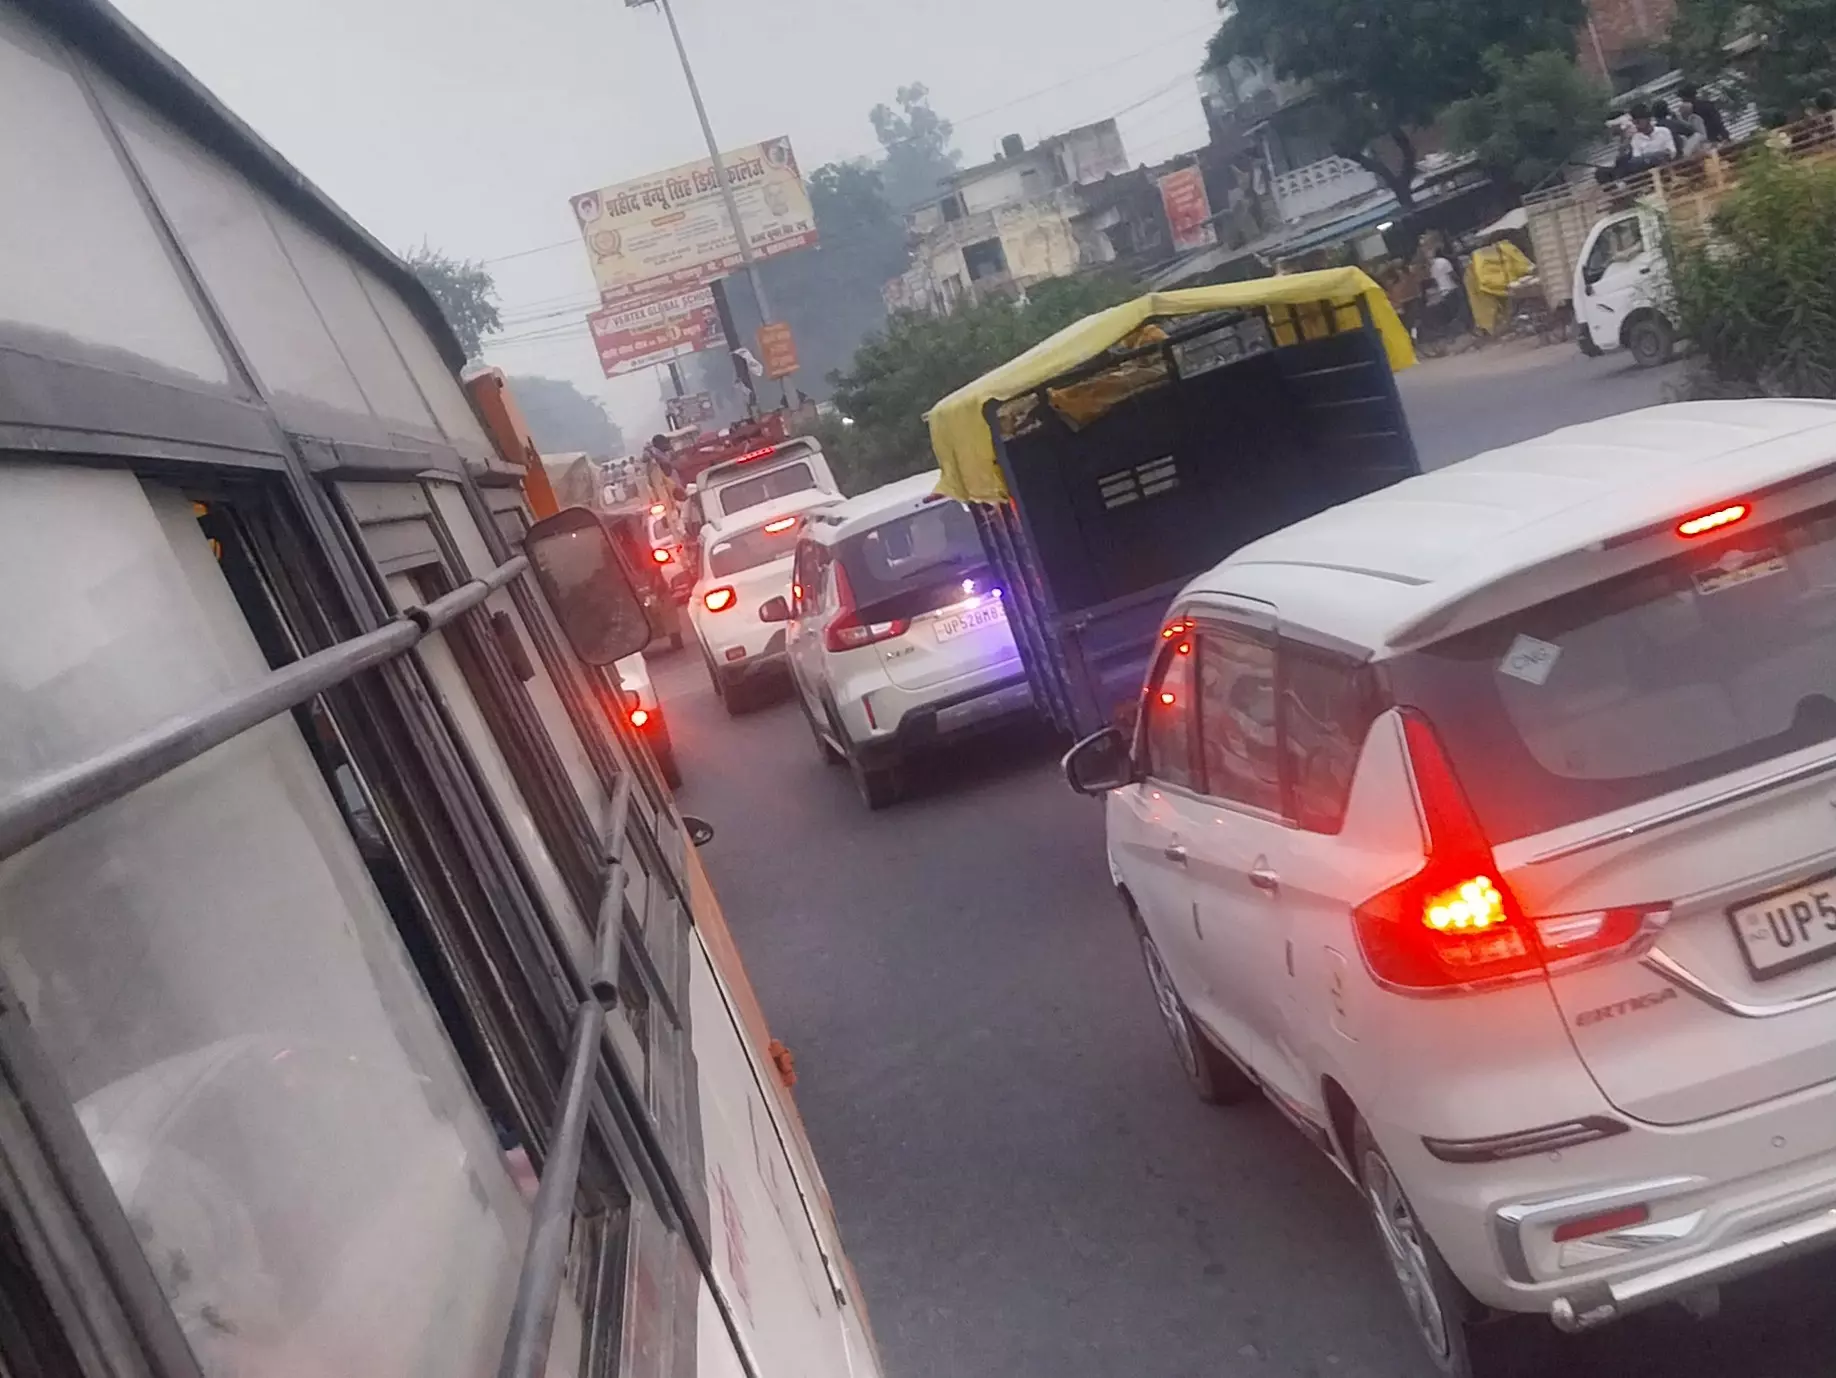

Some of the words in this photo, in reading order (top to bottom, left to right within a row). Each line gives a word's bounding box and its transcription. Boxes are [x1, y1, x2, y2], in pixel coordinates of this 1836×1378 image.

[605, 191, 641, 218] शहीद
[666, 175, 693, 200] सिंह
[612, 311, 646, 327] VERTEX
[647, 299, 680, 316] GLOBAL
[682, 289, 714, 306] SCHOO
[1766, 891, 1836, 949] UP5
[1576, 987, 1678, 1027] ERTIGA
